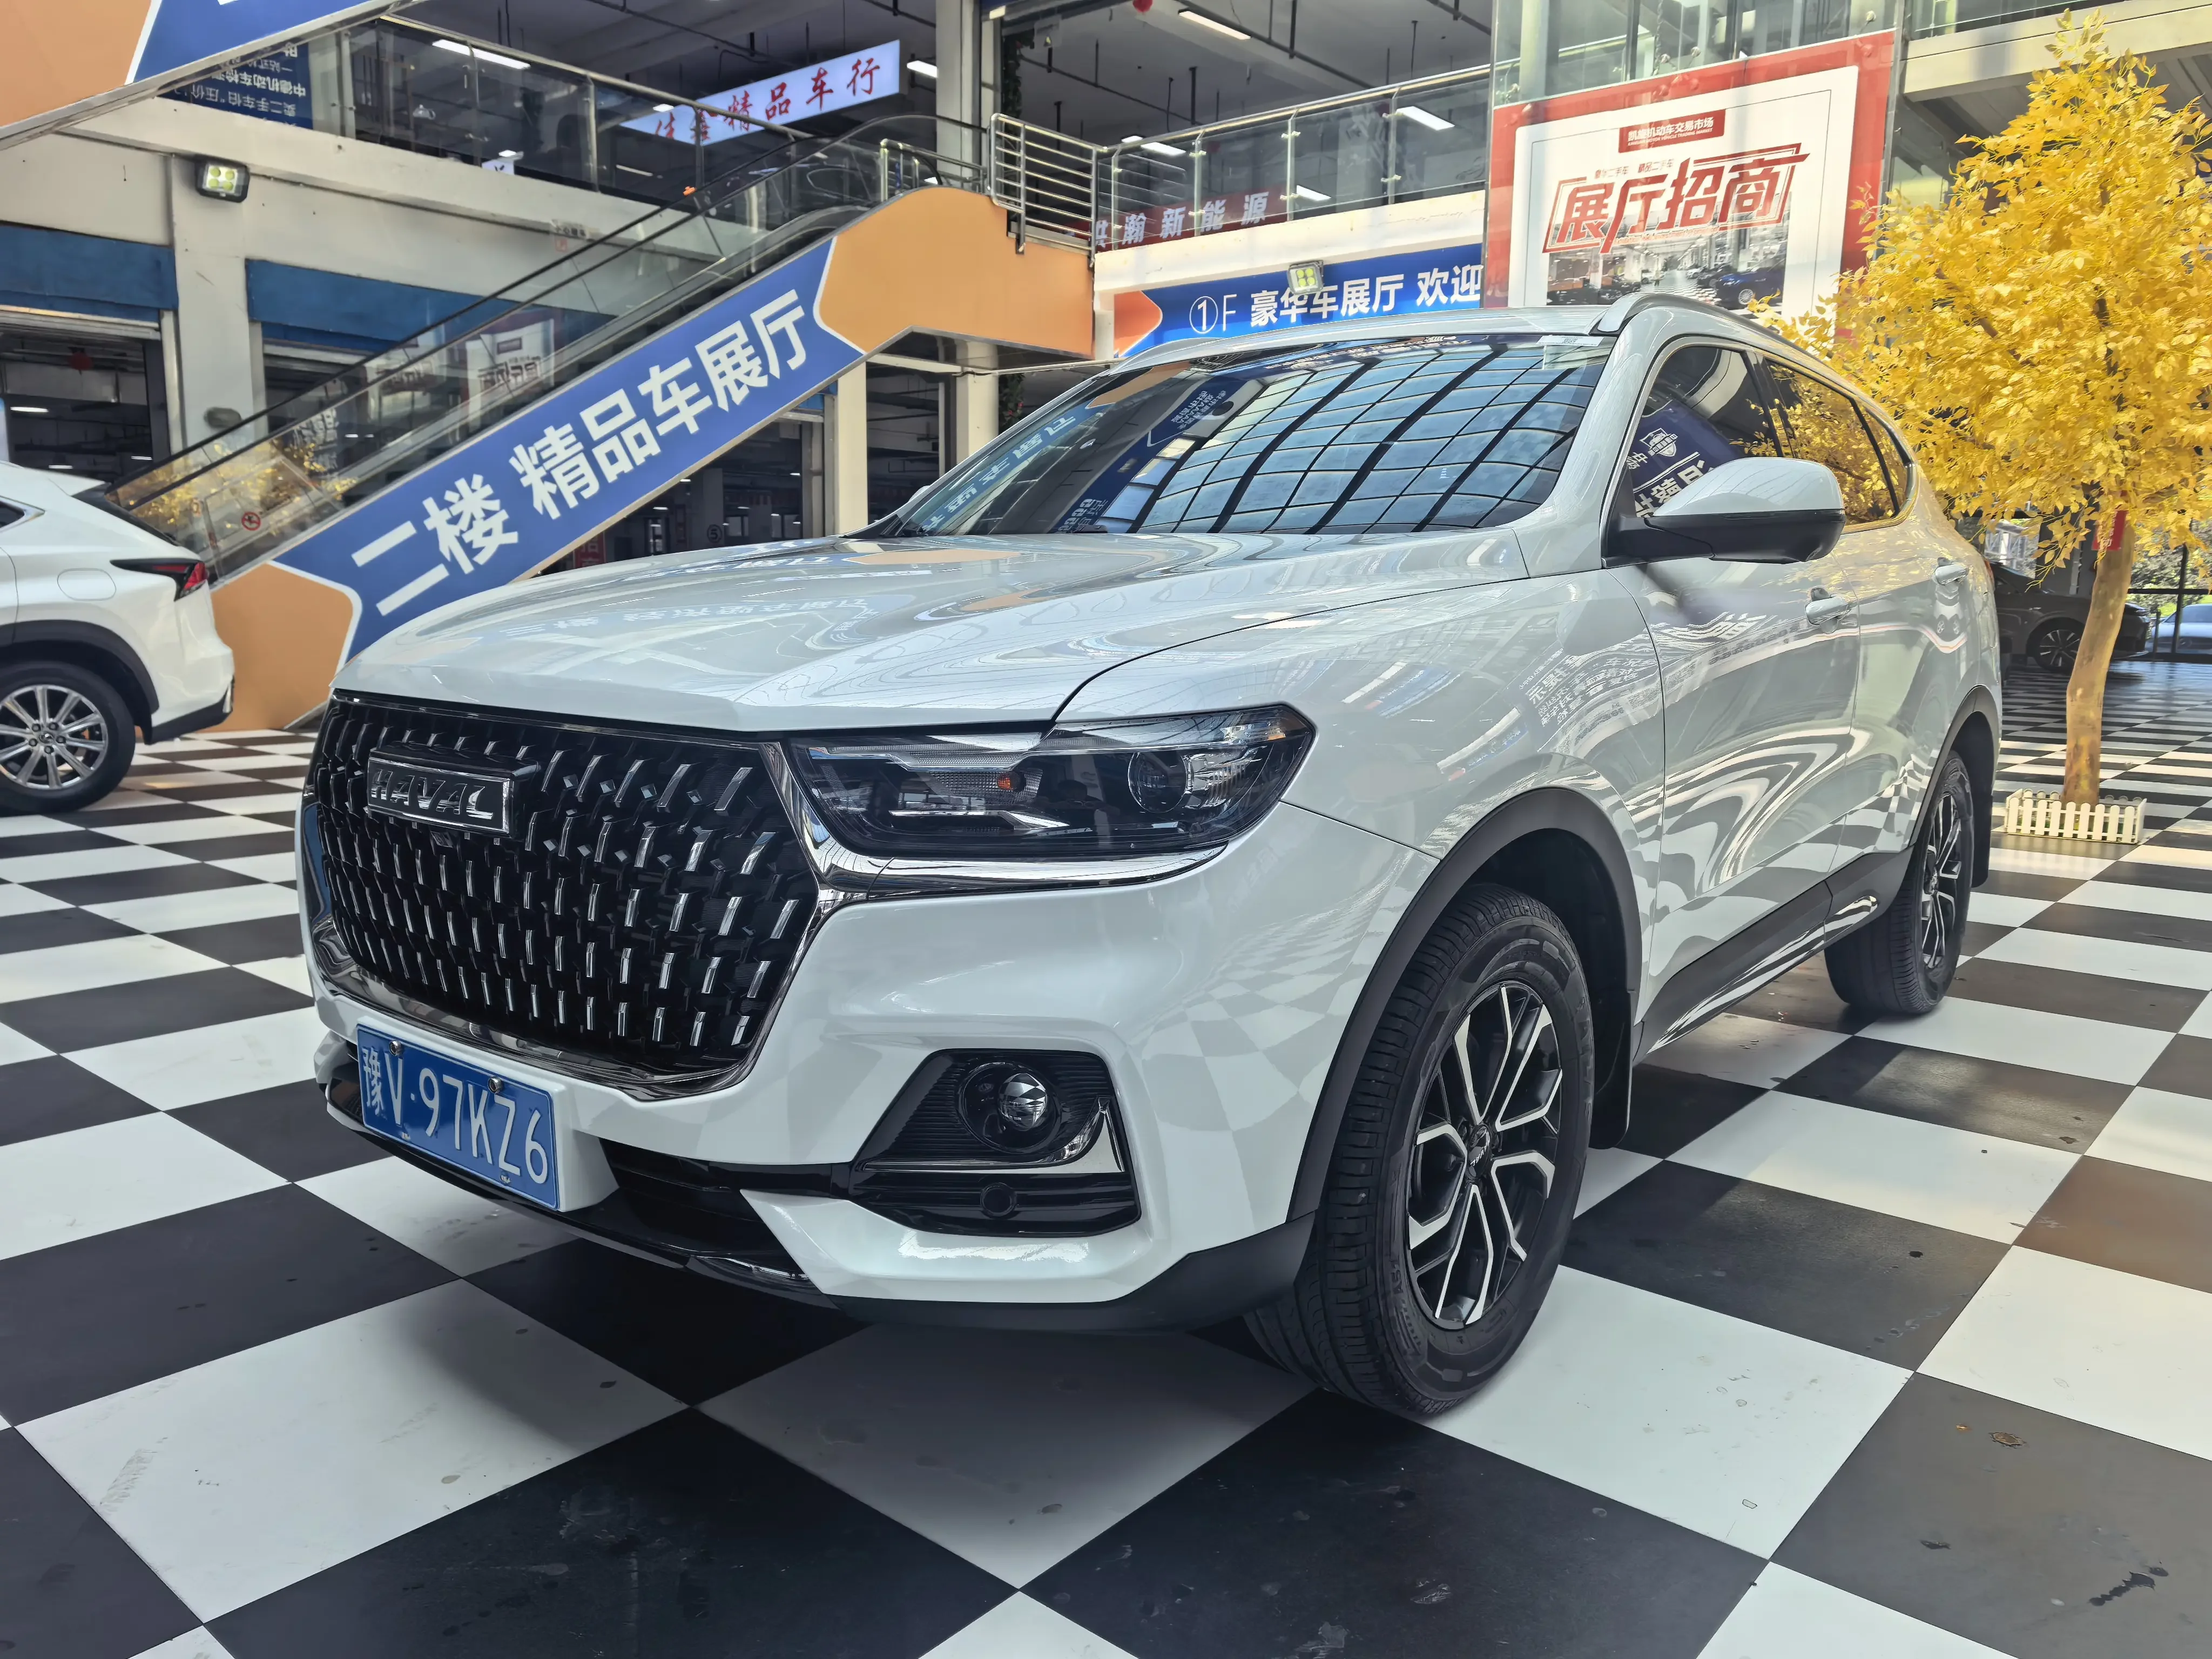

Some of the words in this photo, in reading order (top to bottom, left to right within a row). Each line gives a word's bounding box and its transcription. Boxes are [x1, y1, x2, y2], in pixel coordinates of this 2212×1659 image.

[1556, 153, 1809, 254] 展厅招商
[1250, 274, 1403, 327] 豪华车展厅
[351, 473, 520, 617] 二楼
[509, 288, 808, 521] 精品车展厅
[370, 768, 494, 820] HAVAL
